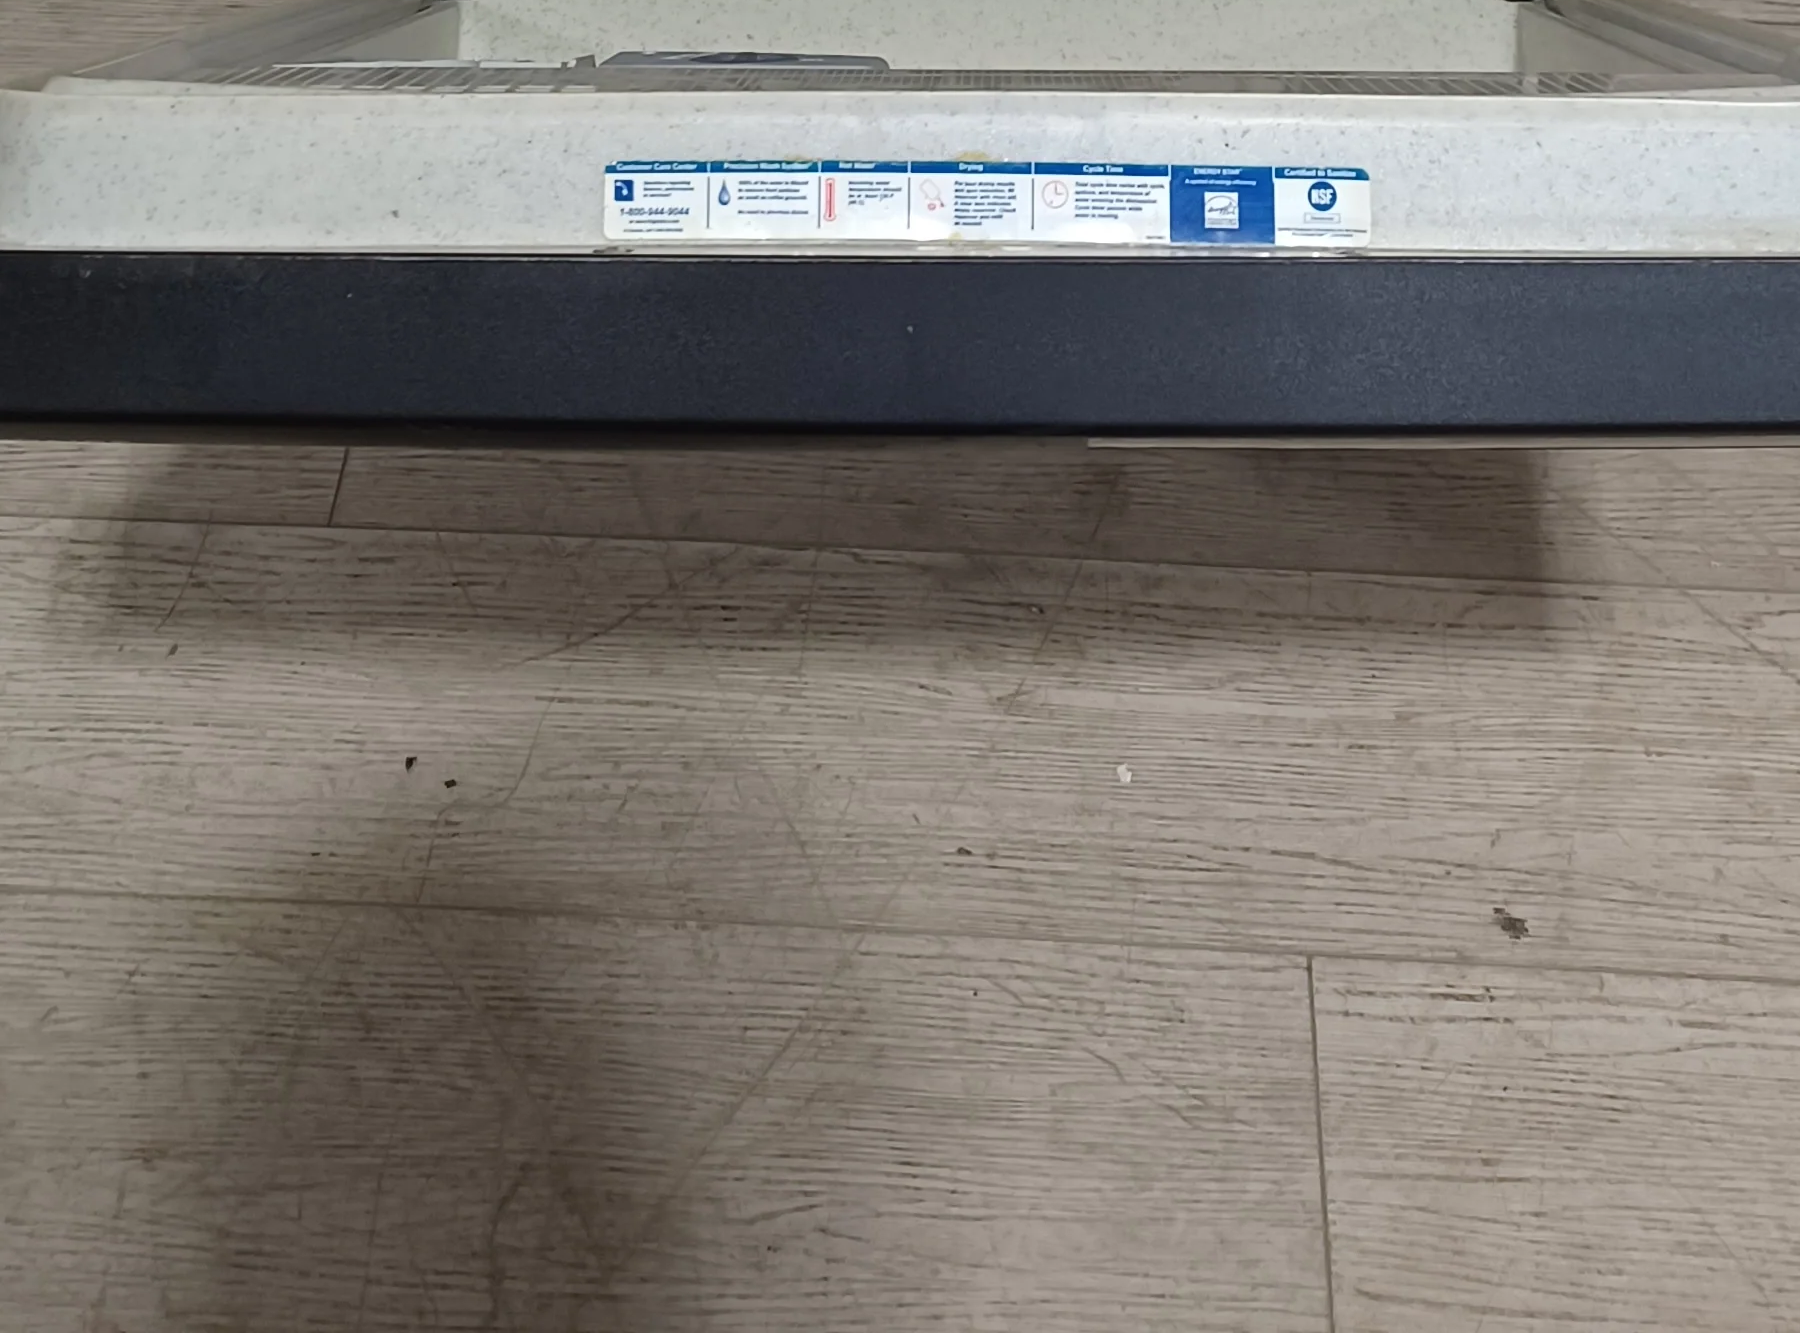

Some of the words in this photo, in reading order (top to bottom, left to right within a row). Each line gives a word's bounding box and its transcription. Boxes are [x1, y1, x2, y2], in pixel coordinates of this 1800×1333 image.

[958, 162, 984, 172] Drying
[1082, 164, 1104, 173] Cycle
[1106, 165, 1124, 173] Time
[1283, 168, 1316, 177] Certified
[1317, 169, 1326, 177] to
[1310, 188, 1334, 205] NSF
